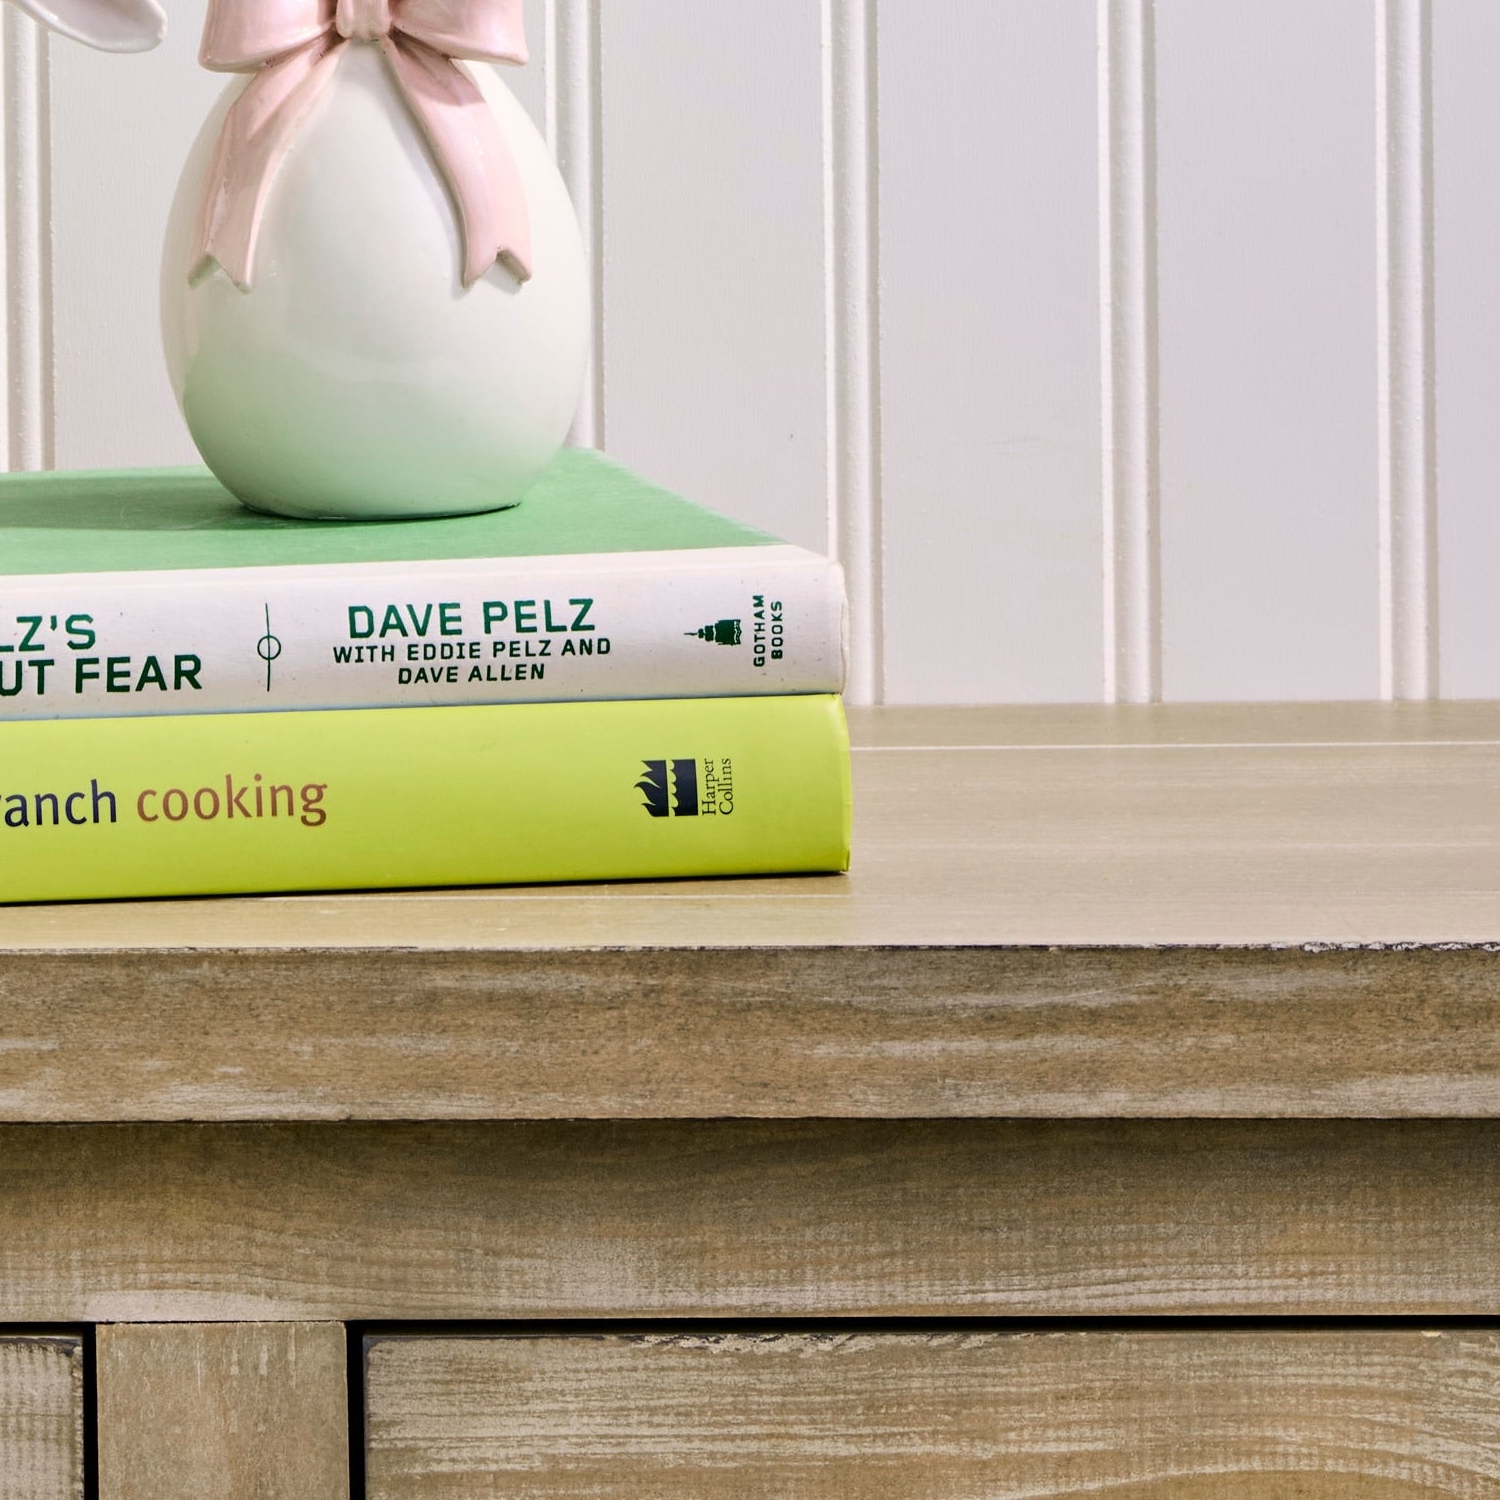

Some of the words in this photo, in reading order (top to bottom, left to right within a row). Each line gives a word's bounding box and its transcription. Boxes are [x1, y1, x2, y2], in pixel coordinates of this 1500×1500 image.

[348, 602, 463, 640] DAVE
[482, 598, 596, 635] PELZ
[752, 595, 766, 668] GOTHAM
[770, 601, 784, 660] BOOKS
[74, 654, 203, 694] FEAR
[332, 644, 395, 664] WITH
[407, 641, 481, 661] EDDIE
[492, 639, 552, 658] PELZ
[560, 637, 611, 657] AND
[398, 666, 459, 685] DAVE
[467, 663, 545, 683] ALLEN
[137, 773, 328, 827] cooking
[701, 758, 719, 816] Harper
[718, 757, 735, 816] Collins
